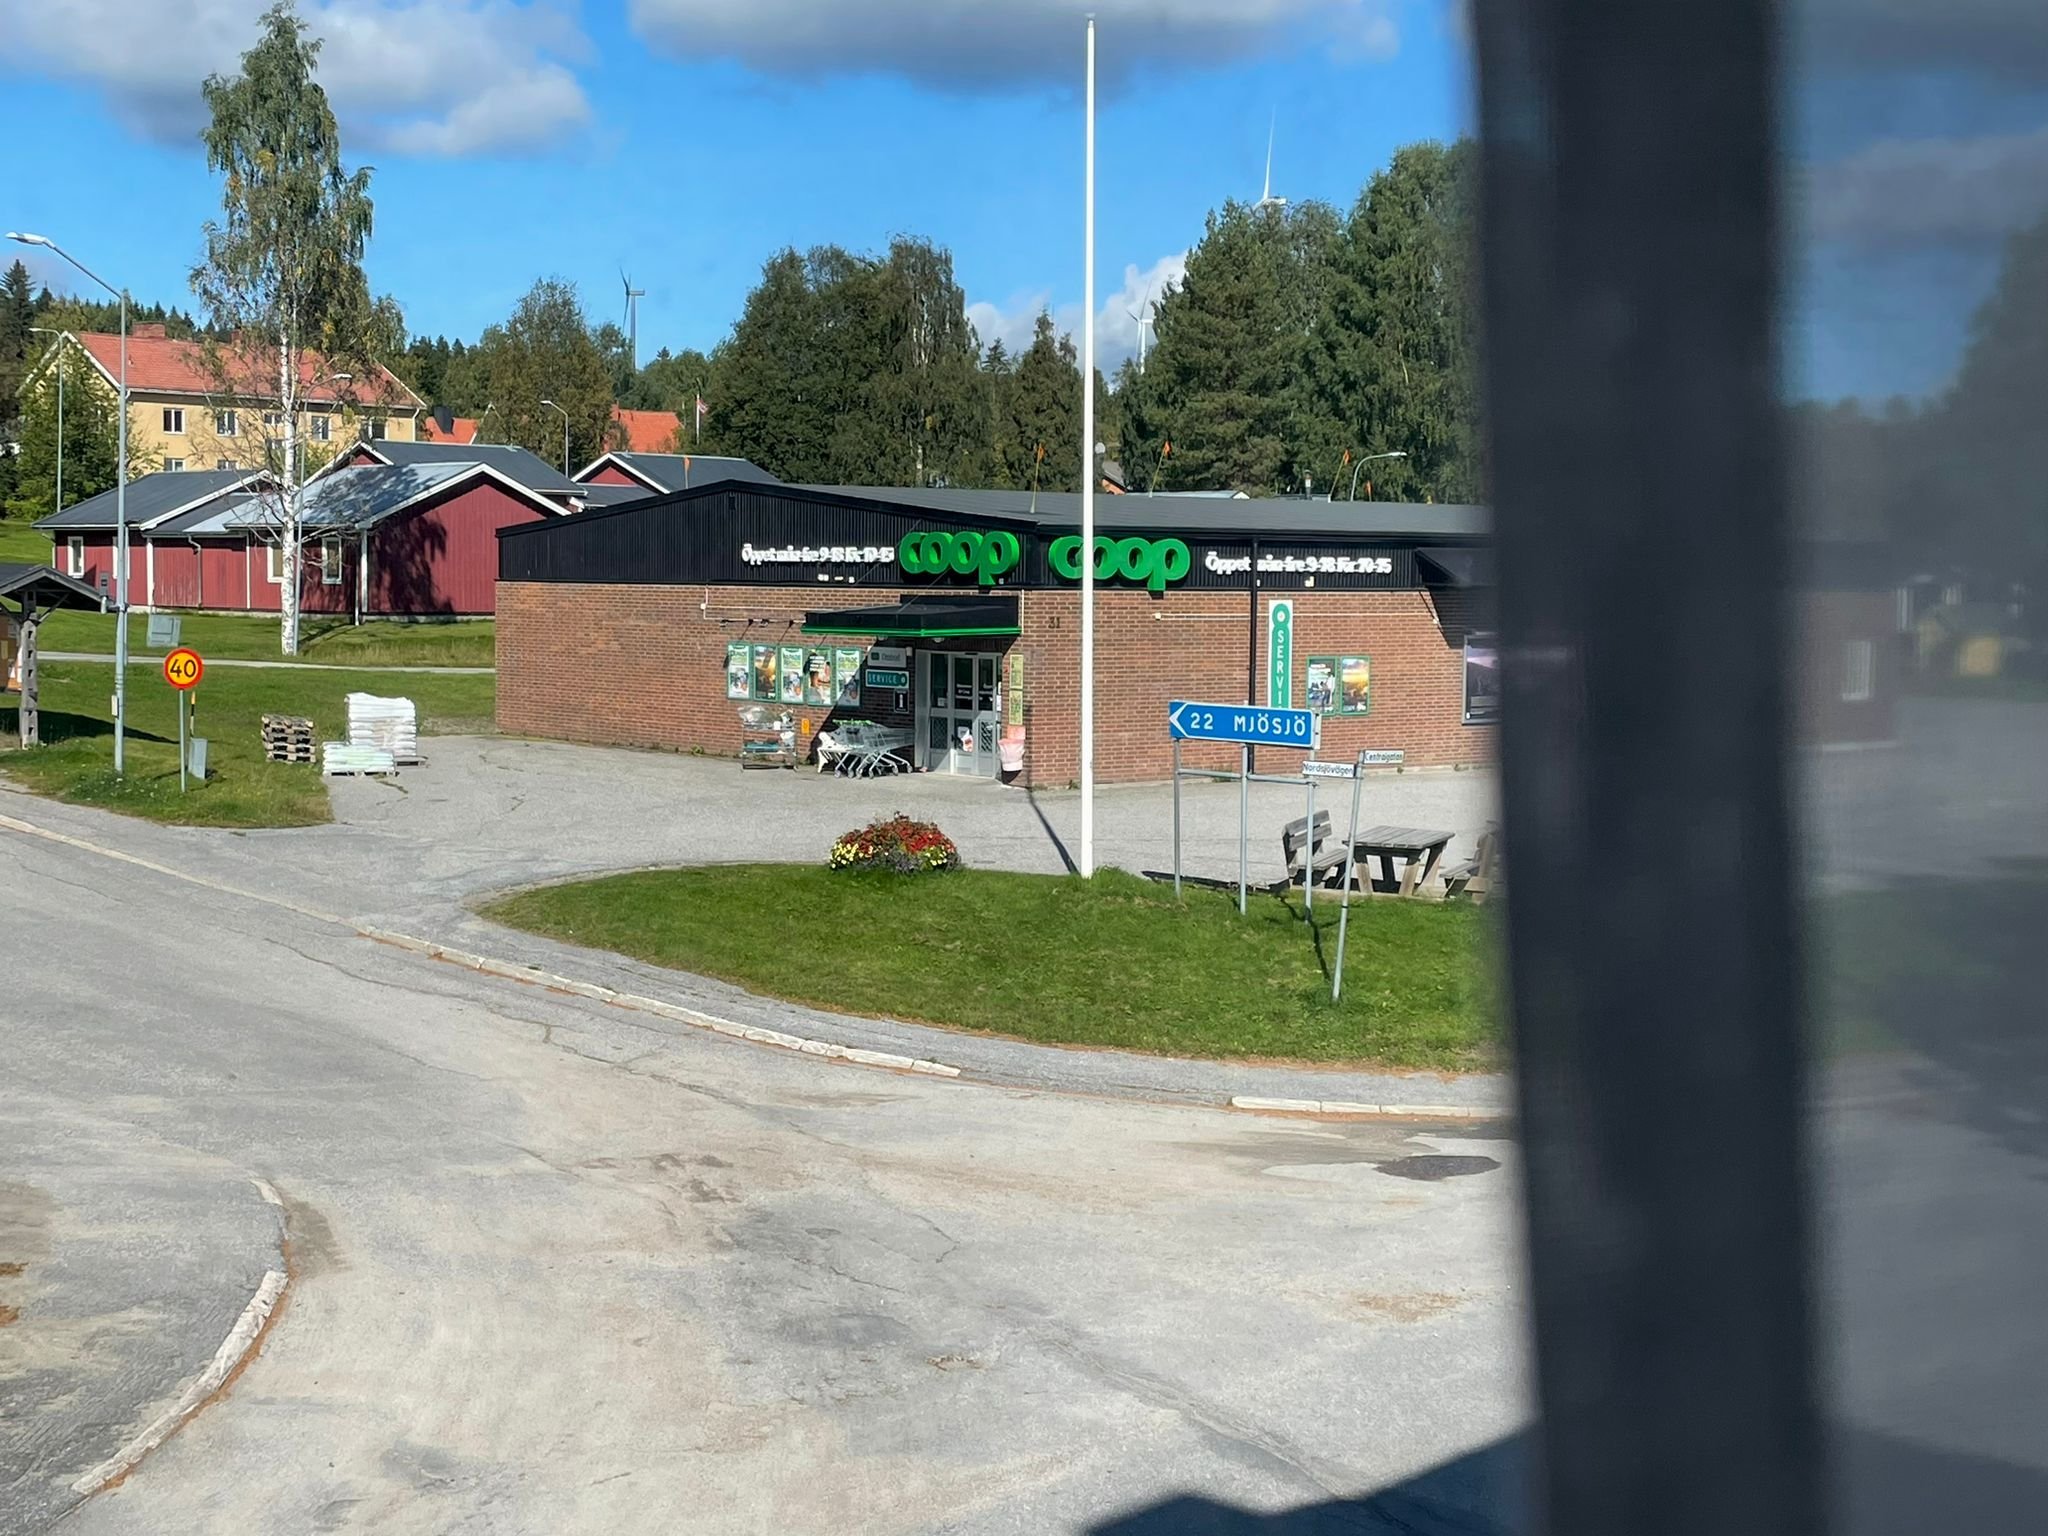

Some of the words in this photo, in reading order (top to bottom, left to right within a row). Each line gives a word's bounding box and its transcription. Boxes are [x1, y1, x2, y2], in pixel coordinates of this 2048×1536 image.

[899, 531, 1020, 586] coop
[1048, 535, 1191, 592] coop
[1204, 551, 1252, 575] Öppet
[170, 659, 197, 678] 40
[868, 673, 898, 685] SERVICE
[1190, 712, 1214, 730] 22
[1233, 712, 1306, 736] MJÖSJÖ
[1302, 763, 1353, 776] Nordsjövägen
